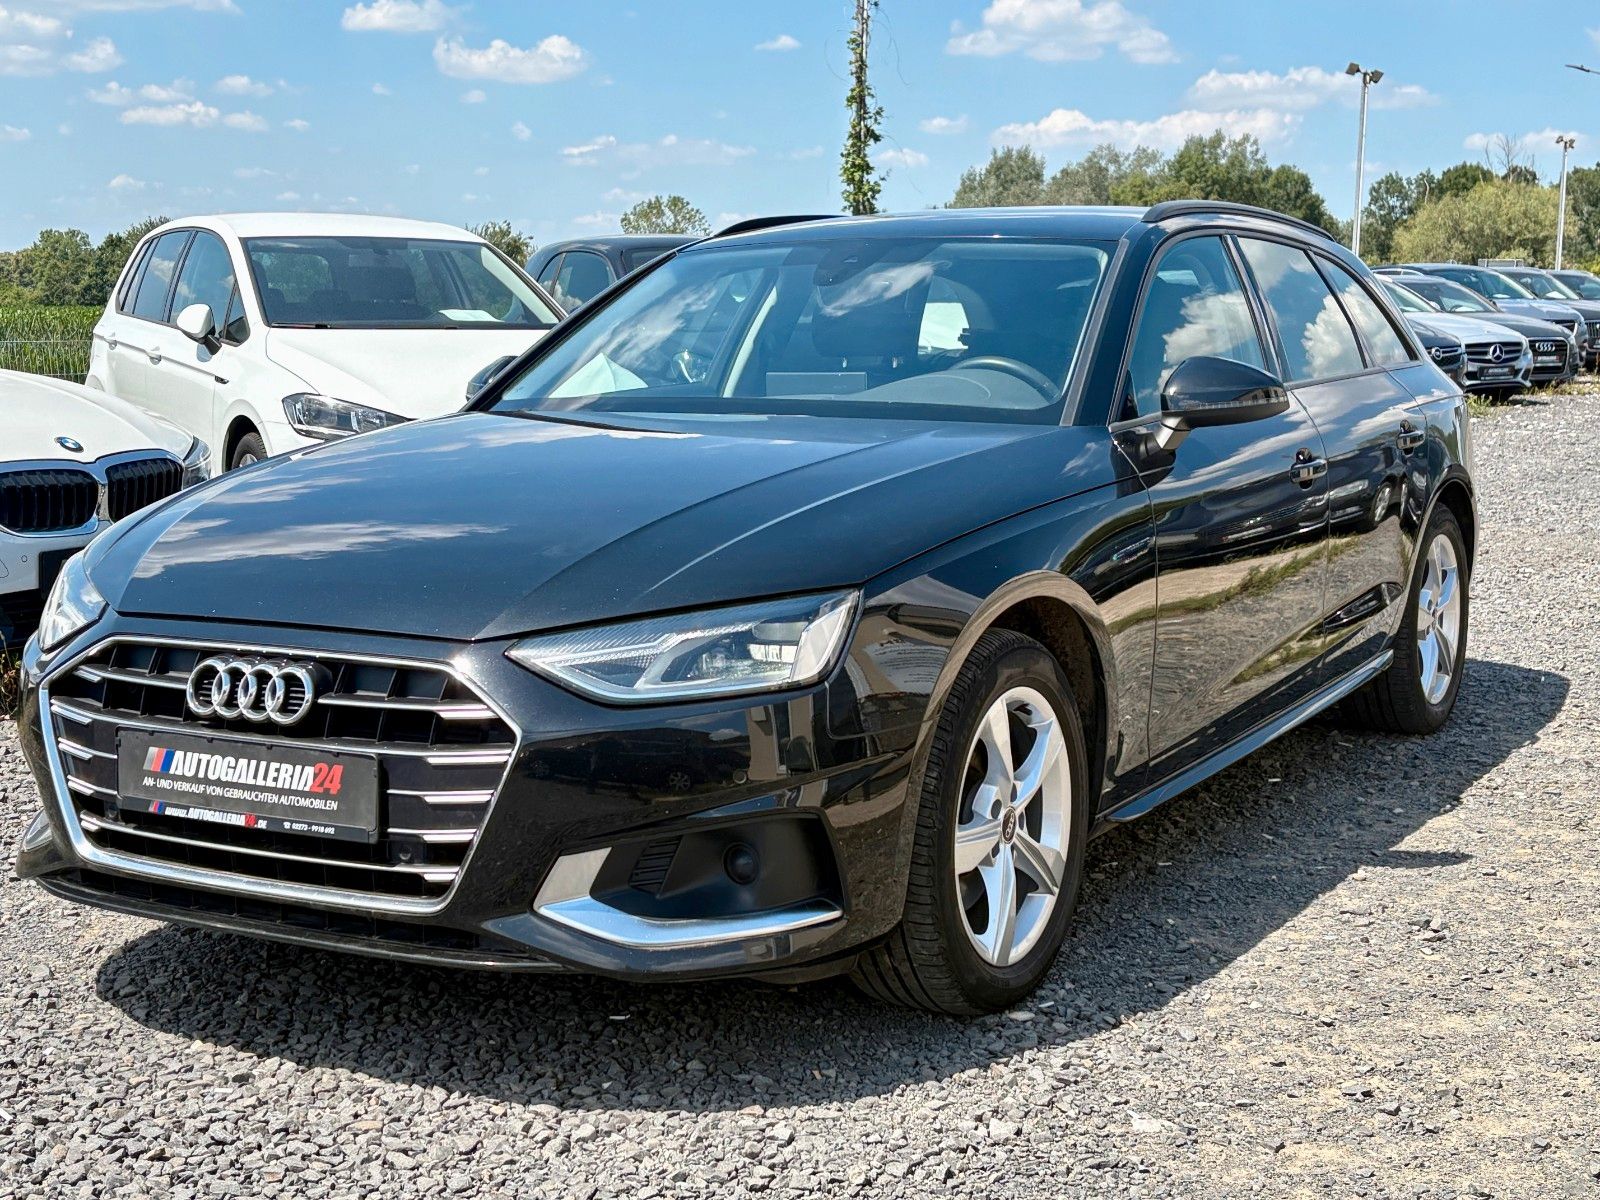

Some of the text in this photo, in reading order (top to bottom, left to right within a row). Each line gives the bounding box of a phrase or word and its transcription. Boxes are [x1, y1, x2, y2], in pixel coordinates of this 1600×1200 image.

[169, 750, 344, 795] AUTOGALLERIA24
[143, 776, 338, 811] AN- UND VERKAUF VON GEBRAUCHTEN AUTOMOBILEN
